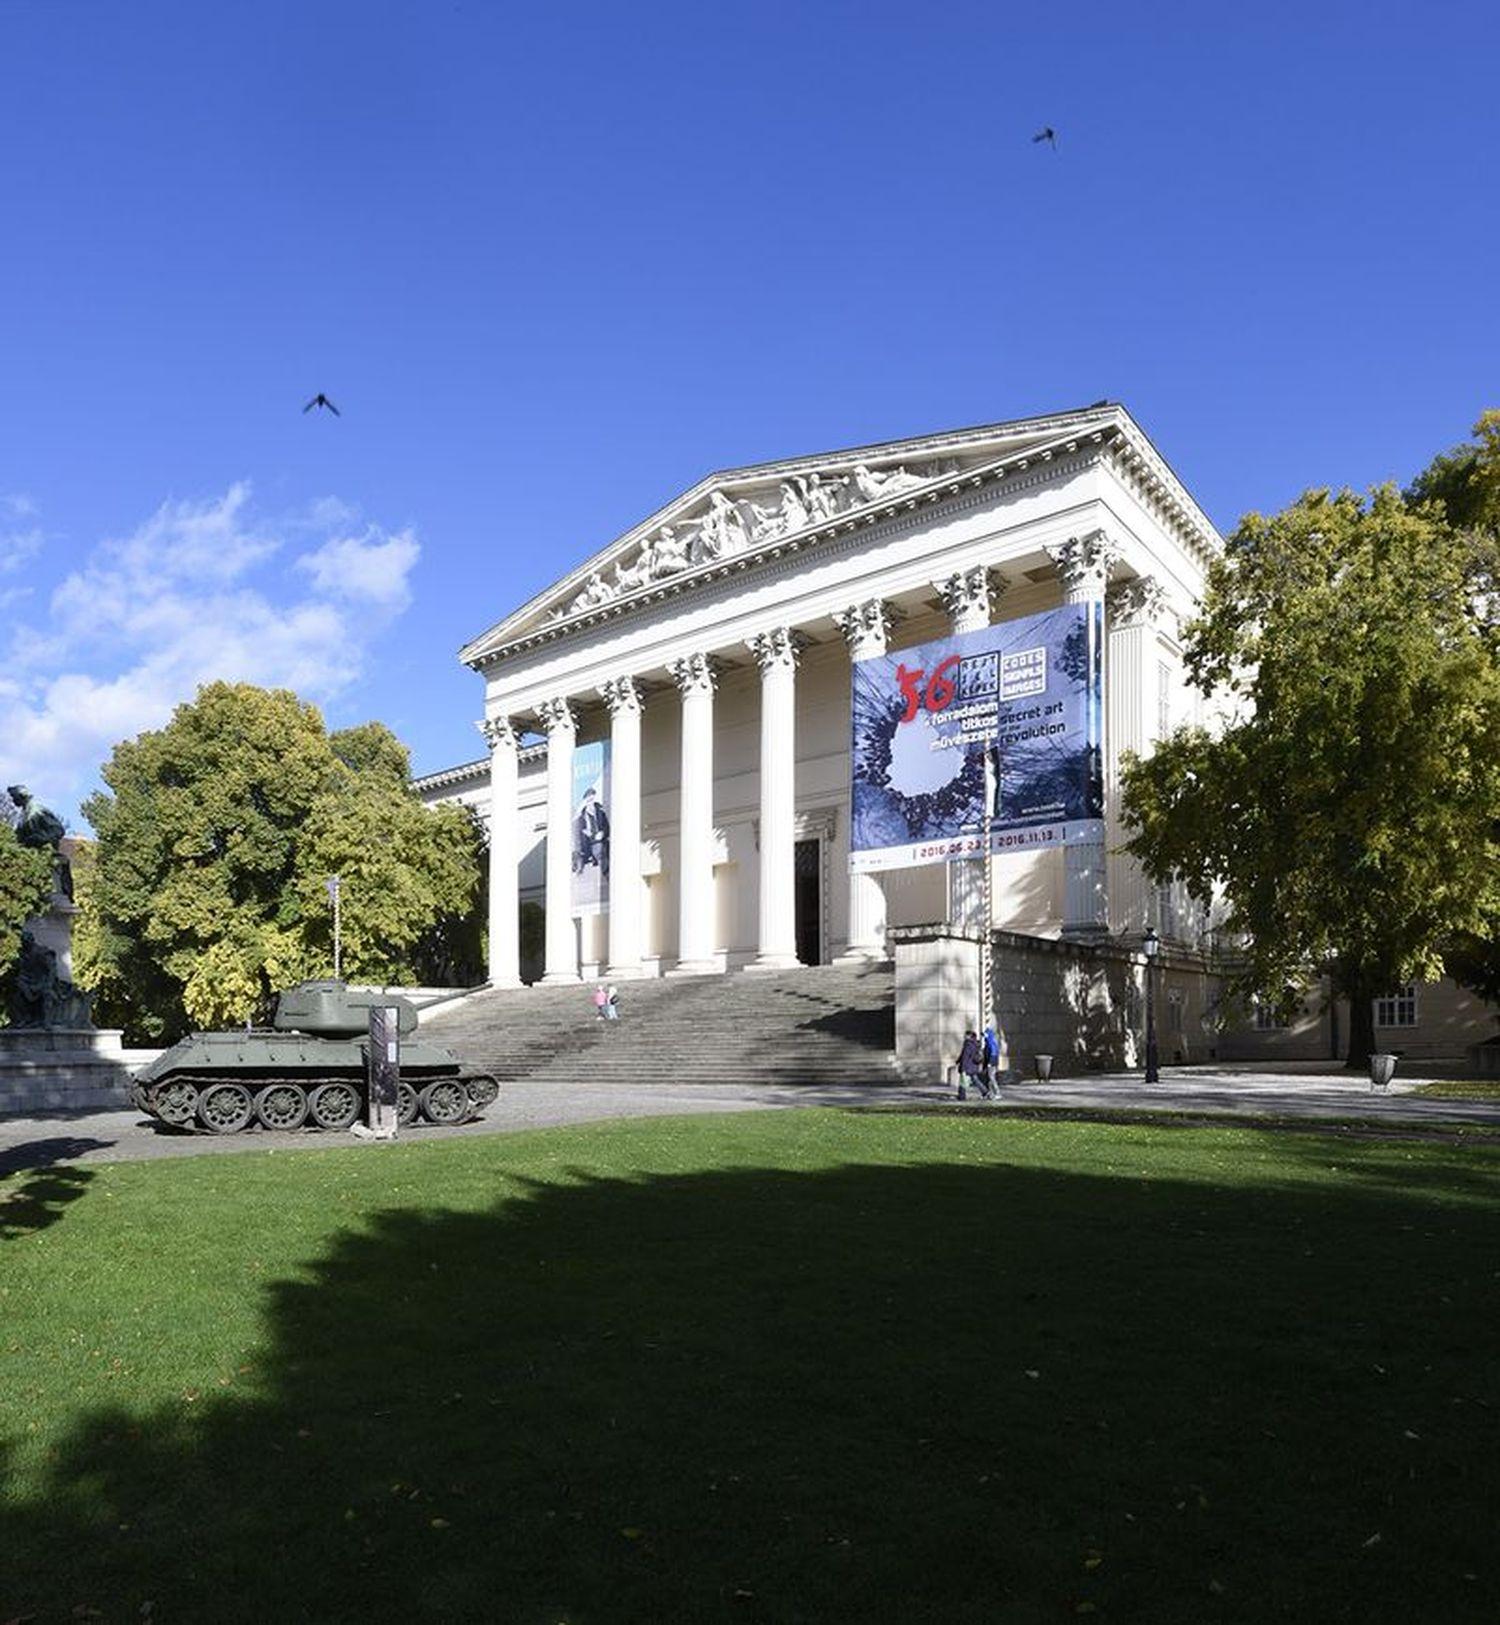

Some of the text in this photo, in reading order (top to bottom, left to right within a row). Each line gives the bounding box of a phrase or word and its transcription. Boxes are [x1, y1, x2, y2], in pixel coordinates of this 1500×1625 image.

[1003, 650, 1043, 669] CODES
[896, 656, 961, 723] 56
[1000, 707, 1041, 724] secret
[1045, 701, 1063, 715] art
[1000, 722, 1066, 745] revolution
